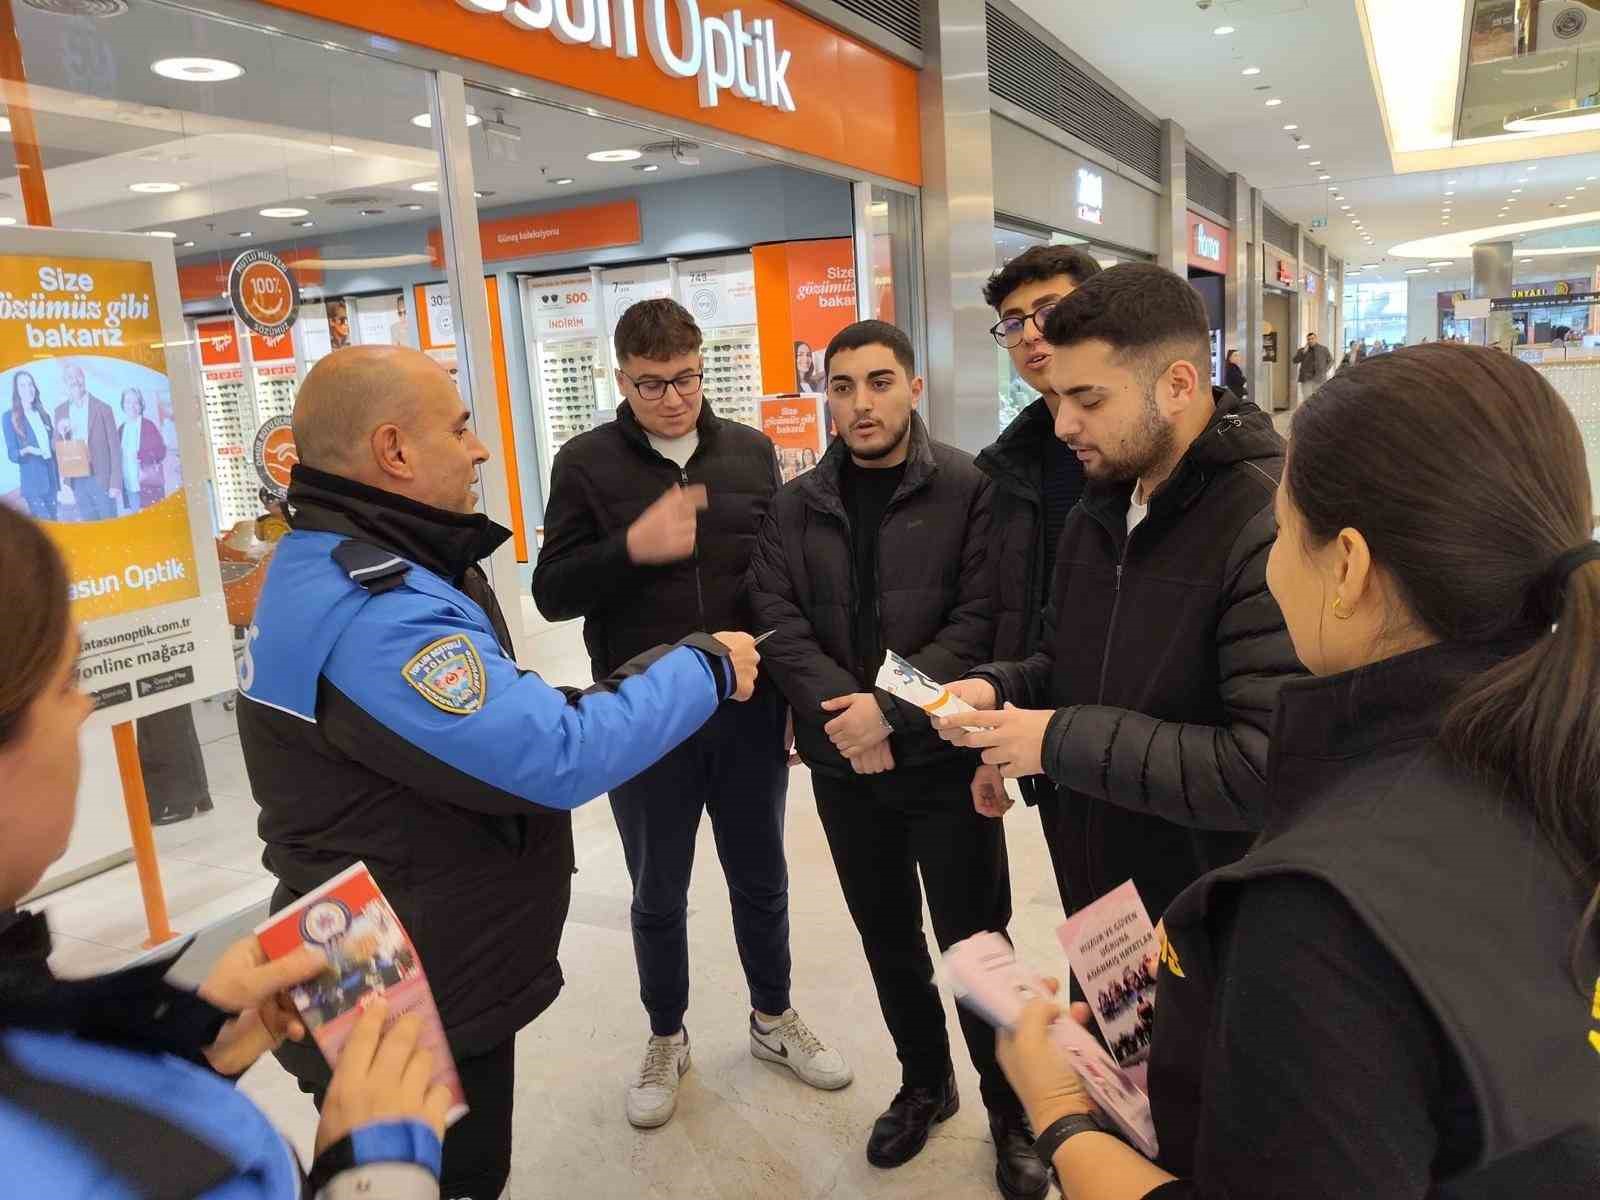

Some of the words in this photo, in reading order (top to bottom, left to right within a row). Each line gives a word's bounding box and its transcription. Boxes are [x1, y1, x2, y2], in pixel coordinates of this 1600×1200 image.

[645, 0, 796, 112] Optik
[38, 266, 94, 292] Size
[826, 266, 855, 279] Size
[250, 277, 280, 295] 100%
[104, 293, 149, 329] gibi
[26, 323, 125, 348] bakarız
[124, 557, 185, 591] Optik
[137, 641, 195, 663] mağaza
